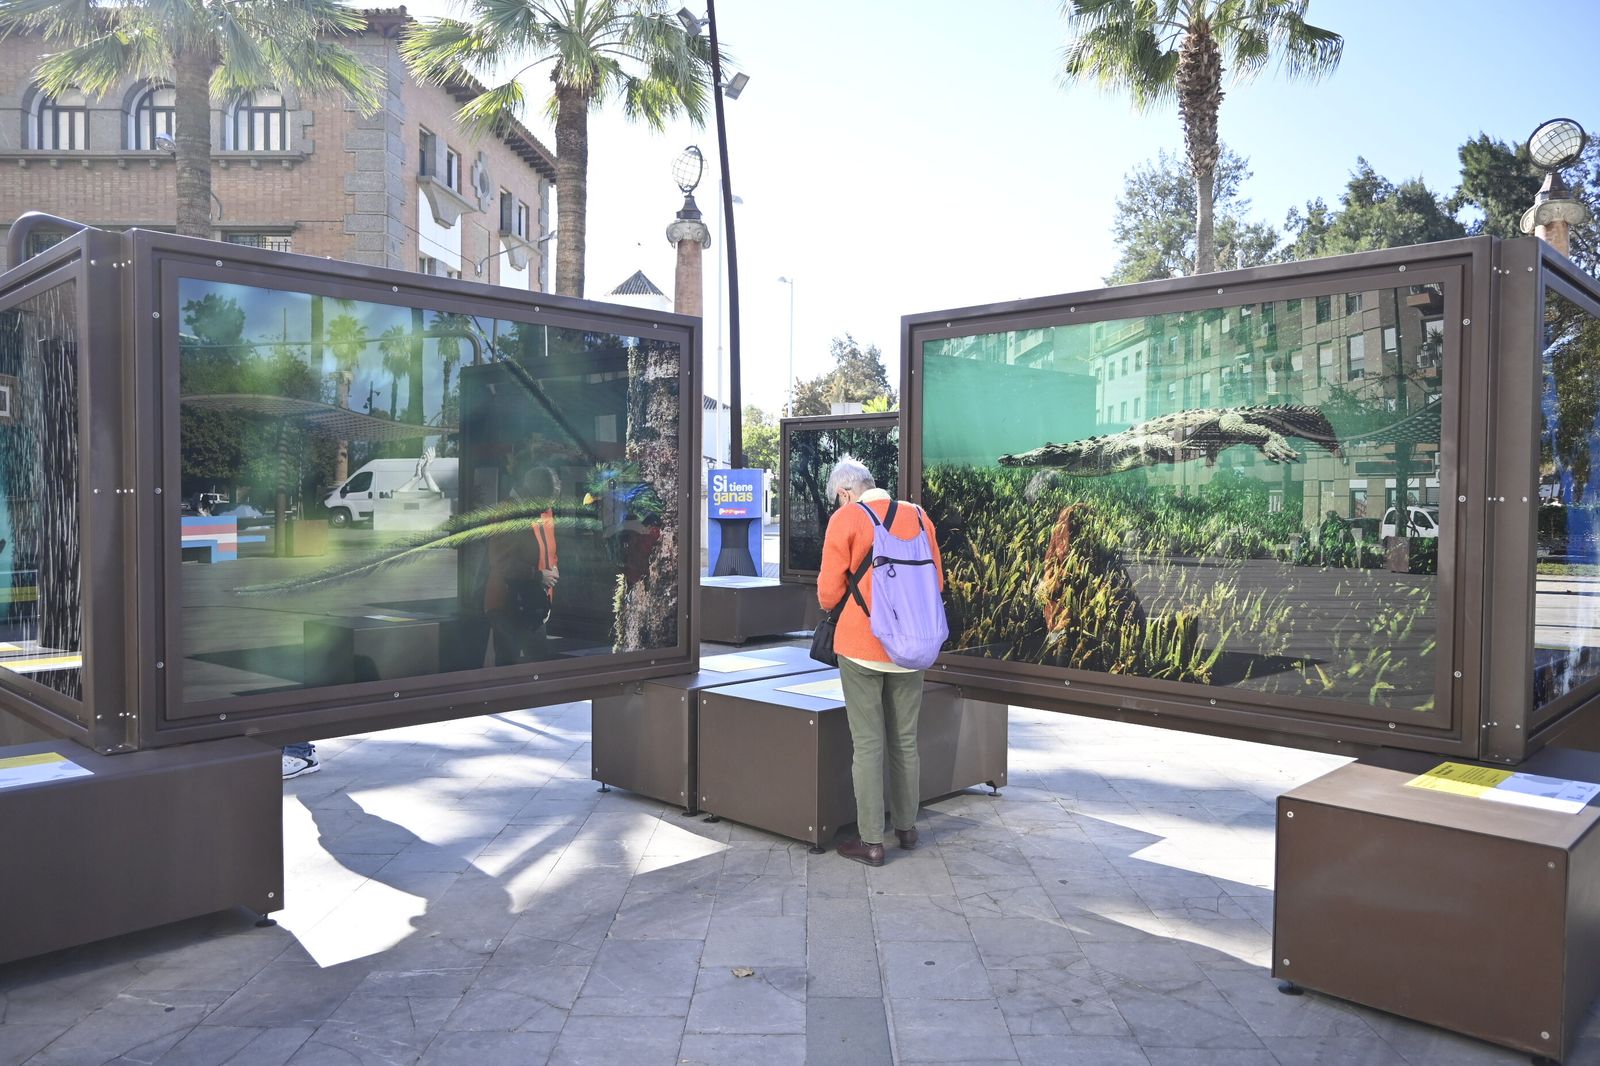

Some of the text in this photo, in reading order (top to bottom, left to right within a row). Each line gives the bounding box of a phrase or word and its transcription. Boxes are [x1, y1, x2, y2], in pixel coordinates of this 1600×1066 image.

[713, 474, 753, 492] Si tiene
[713, 491, 753, 506] ganas
